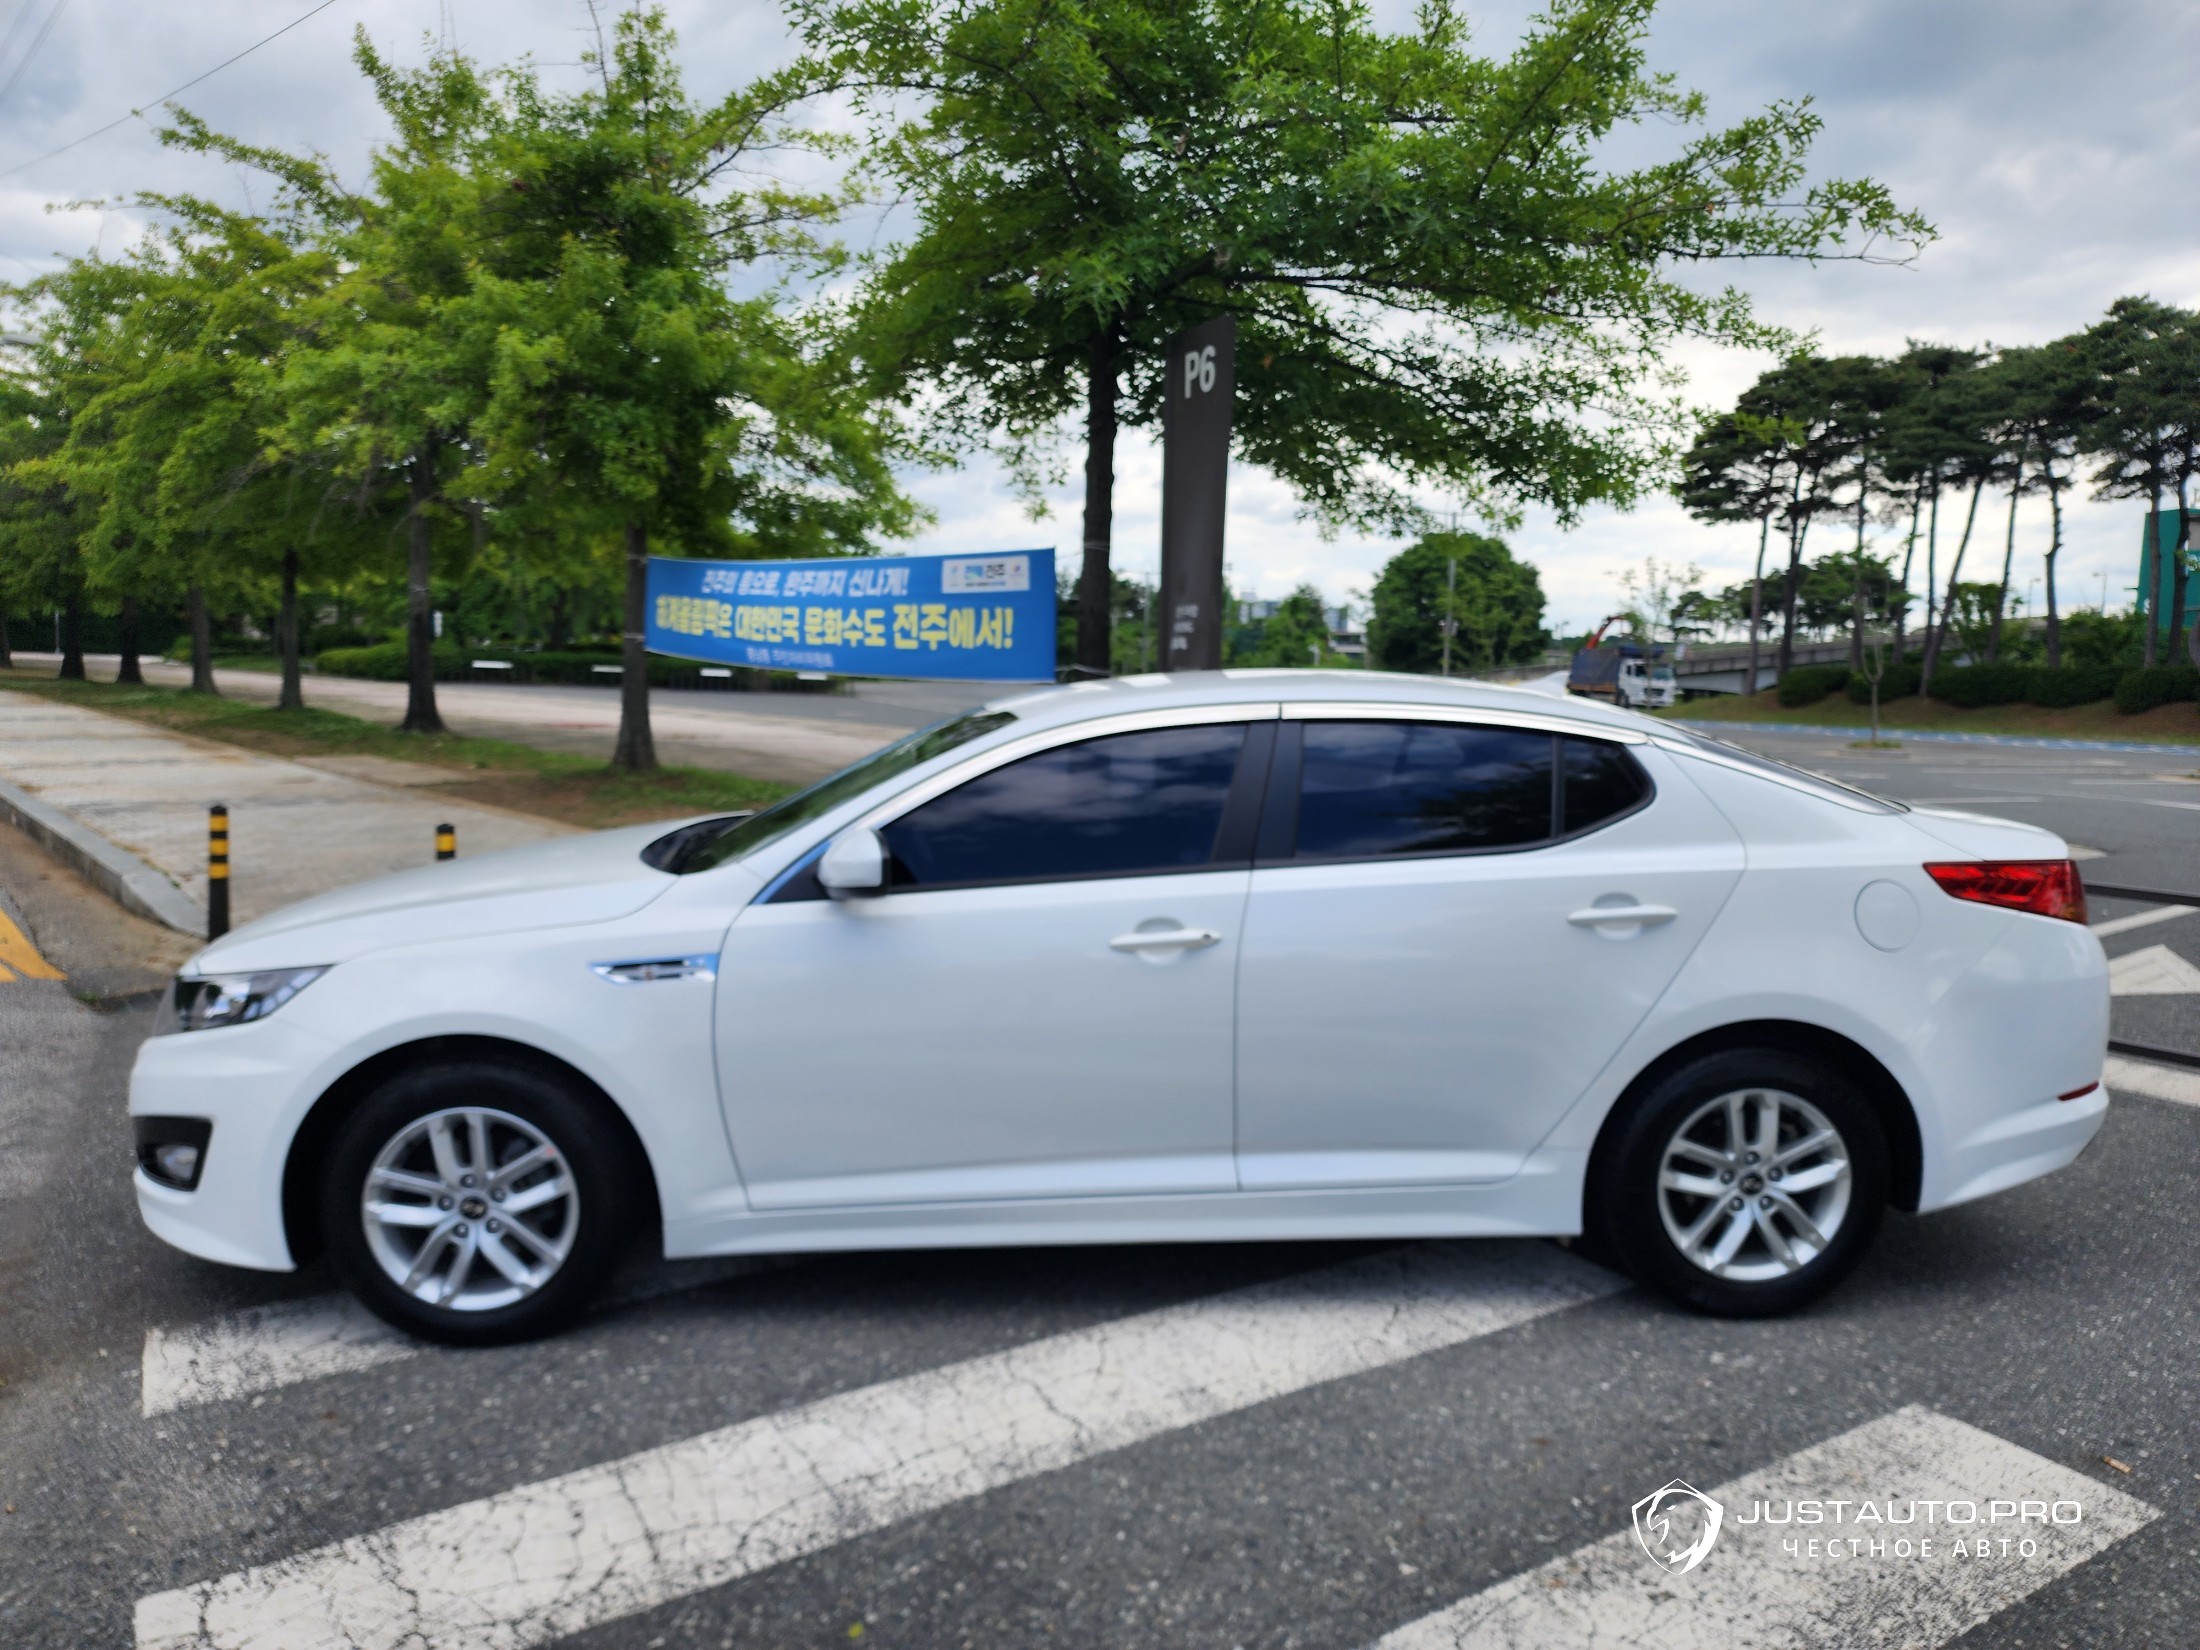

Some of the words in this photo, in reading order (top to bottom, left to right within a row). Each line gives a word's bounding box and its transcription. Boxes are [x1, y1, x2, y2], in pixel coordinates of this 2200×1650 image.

[1185, 345, 1216, 399] P6
[848, 567, 911, 598] 신나게!
[735, 605, 800, 645] 대한민국
[803, 607, 887, 648] 문화수도
[893, 604, 1014, 651] 전주에서!
